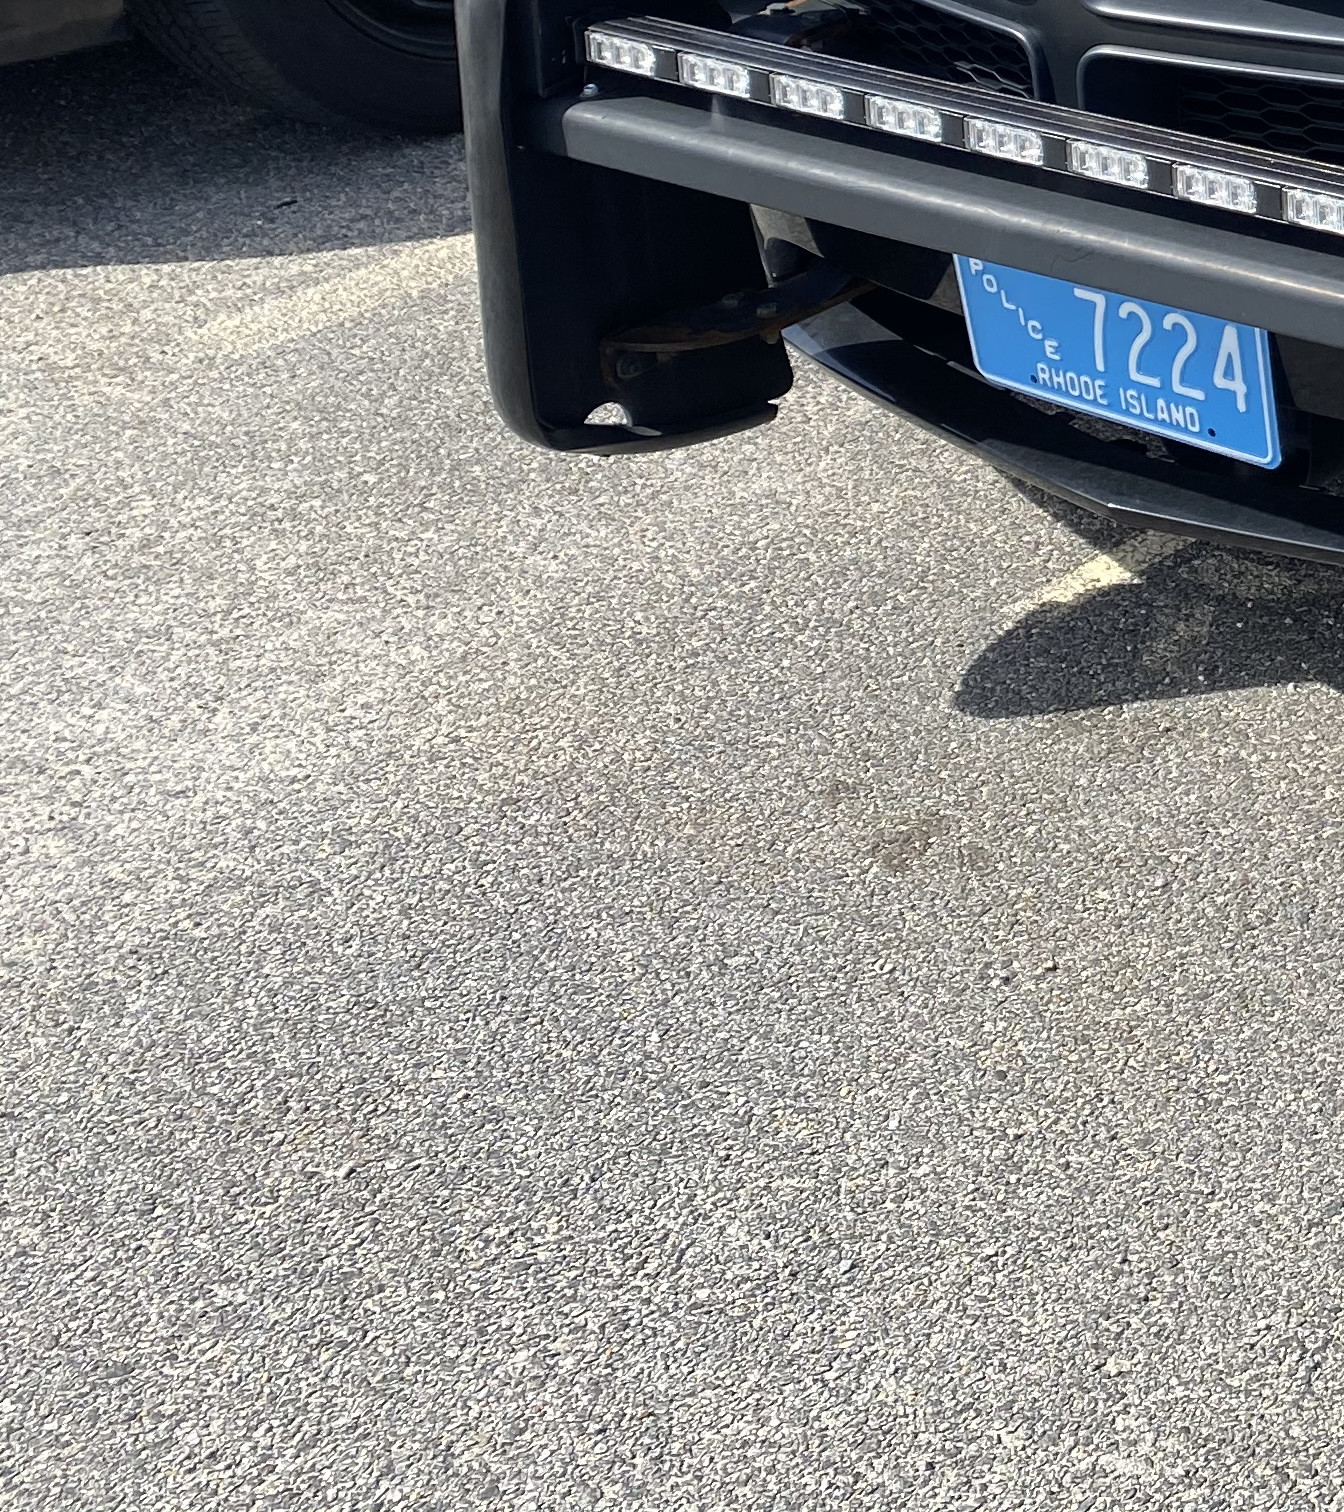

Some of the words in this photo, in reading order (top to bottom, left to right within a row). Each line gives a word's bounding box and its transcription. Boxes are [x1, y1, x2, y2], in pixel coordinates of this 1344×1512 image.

[970, 258, 1062, 361] POLICE
[1073, 287, 1248, 413] 7224
[1036, 361, 1108, 406] RHODE
[1119, 387, 1200, 434] ISLAND
